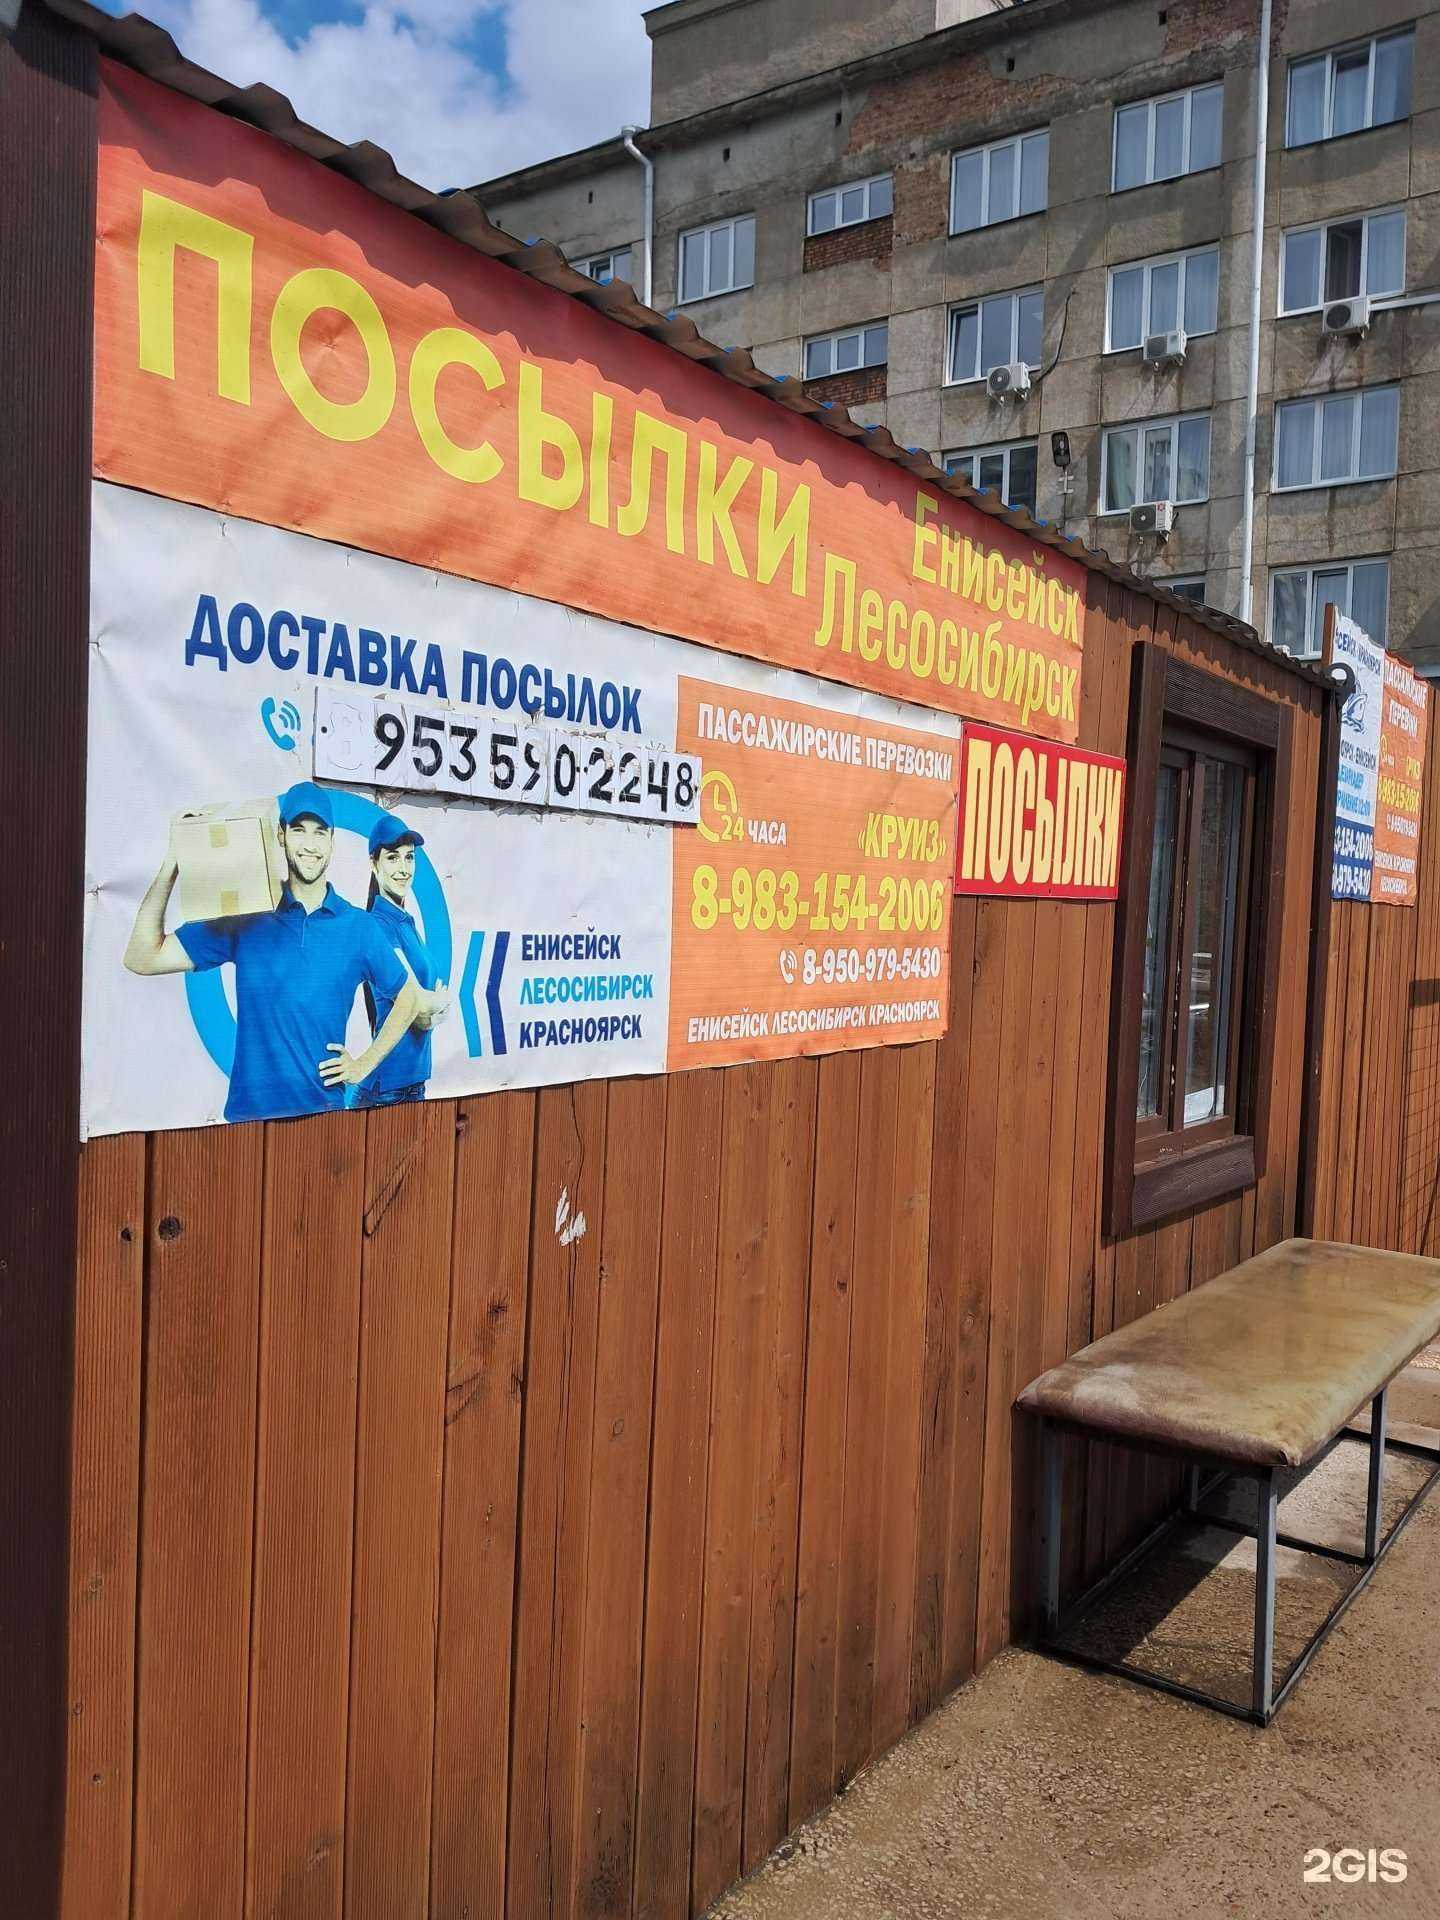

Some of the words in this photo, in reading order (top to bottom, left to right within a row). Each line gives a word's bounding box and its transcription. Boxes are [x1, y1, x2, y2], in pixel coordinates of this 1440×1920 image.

[138, 189, 810, 597] ПОСЫЛКИ
[912, 490, 1080, 644] Енисейск
[185, 594, 448, 699] ДОСТАВКА
[461, 650, 642, 734] ПОСЫЛОК
[815, 552, 1078, 726] Лесосибирск
[698, 703, 862, 766] ПАССАЖИРСКИЕ
[865, 737, 953, 781] ПЕРЕВОЗКИ
[721, 814, 745, 841] 24
[747, 819, 787, 846] ЧАСА
[961, 738, 1122, 887] ПОСЫЛКИ
[691, 864, 944, 932] 8-983-154-2006
[520, 926, 622, 961] ЕНИСЕЙСК
[802, 946, 941, 985] 8-950-979-5430
[519, 974, 654, 1006] ЛЕСОСИБИРСК
[687, 1007, 769, 1043] ЕНИСЕЙСК
[771, 1007, 866, 1035] ЛЕСОСИБИРСК
[868, 999, 940, 1027] КРАСНОЯРСК
[519, 1014, 642, 1049] КРАСНОЯРСК
